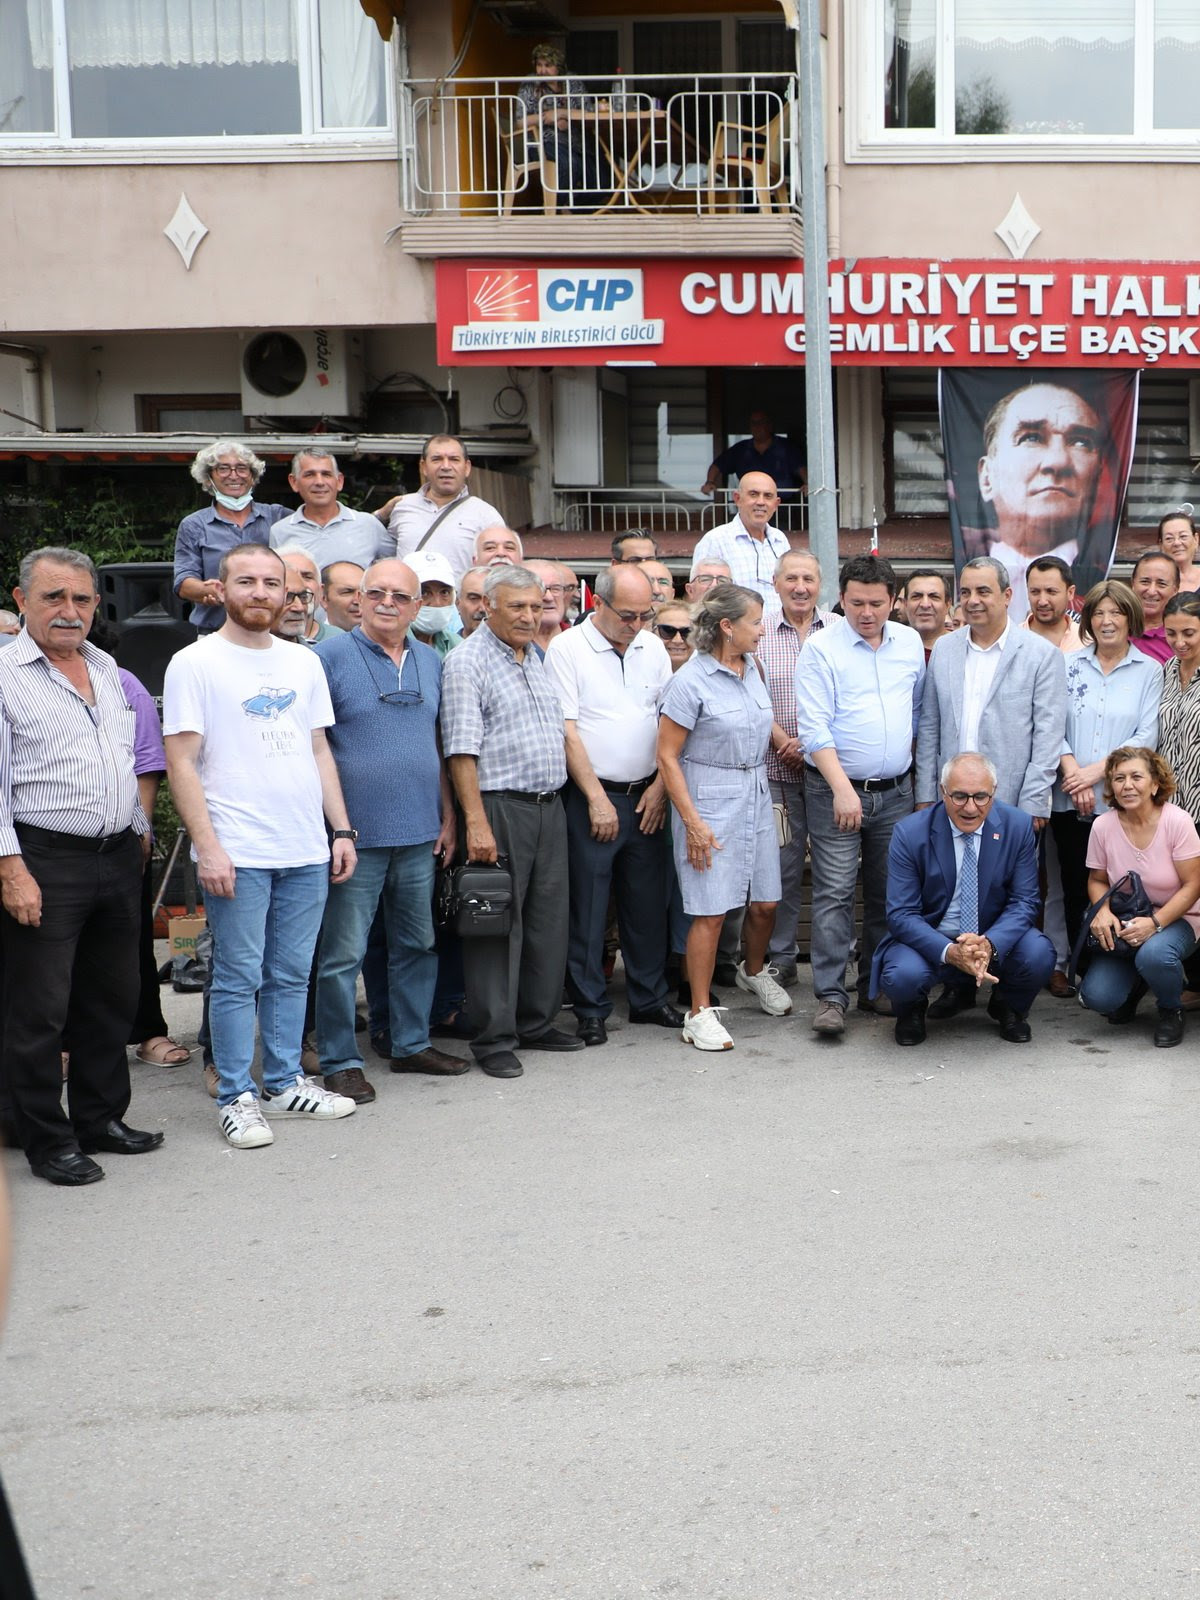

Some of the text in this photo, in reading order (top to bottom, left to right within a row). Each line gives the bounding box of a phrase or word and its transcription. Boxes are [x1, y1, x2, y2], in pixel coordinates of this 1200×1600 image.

[546, 279, 634, 312] CHP
[458, 323, 655, 347] TÜRKİYE'NİN BİRLEŞTİRİCİ GÜCÜ
[784, 319, 955, 353] GEMLİK
[969, 318, 1067, 359] İLÇE
